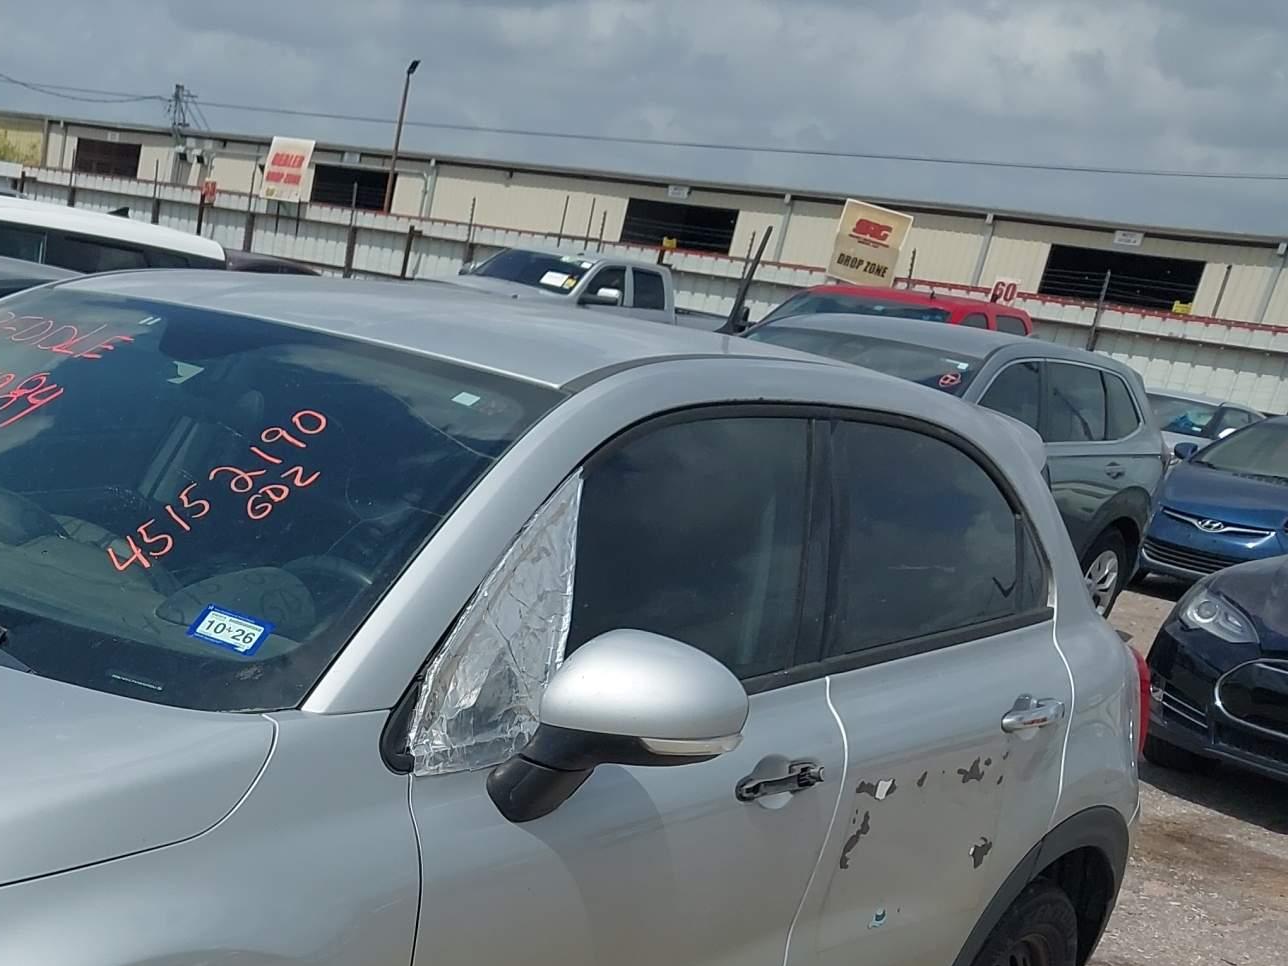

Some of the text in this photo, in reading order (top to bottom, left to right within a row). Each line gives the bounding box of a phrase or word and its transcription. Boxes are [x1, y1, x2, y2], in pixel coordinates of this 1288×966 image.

[836, 252, 888, 278] DROP ZONE
[993, 281, 1017, 302] 60
